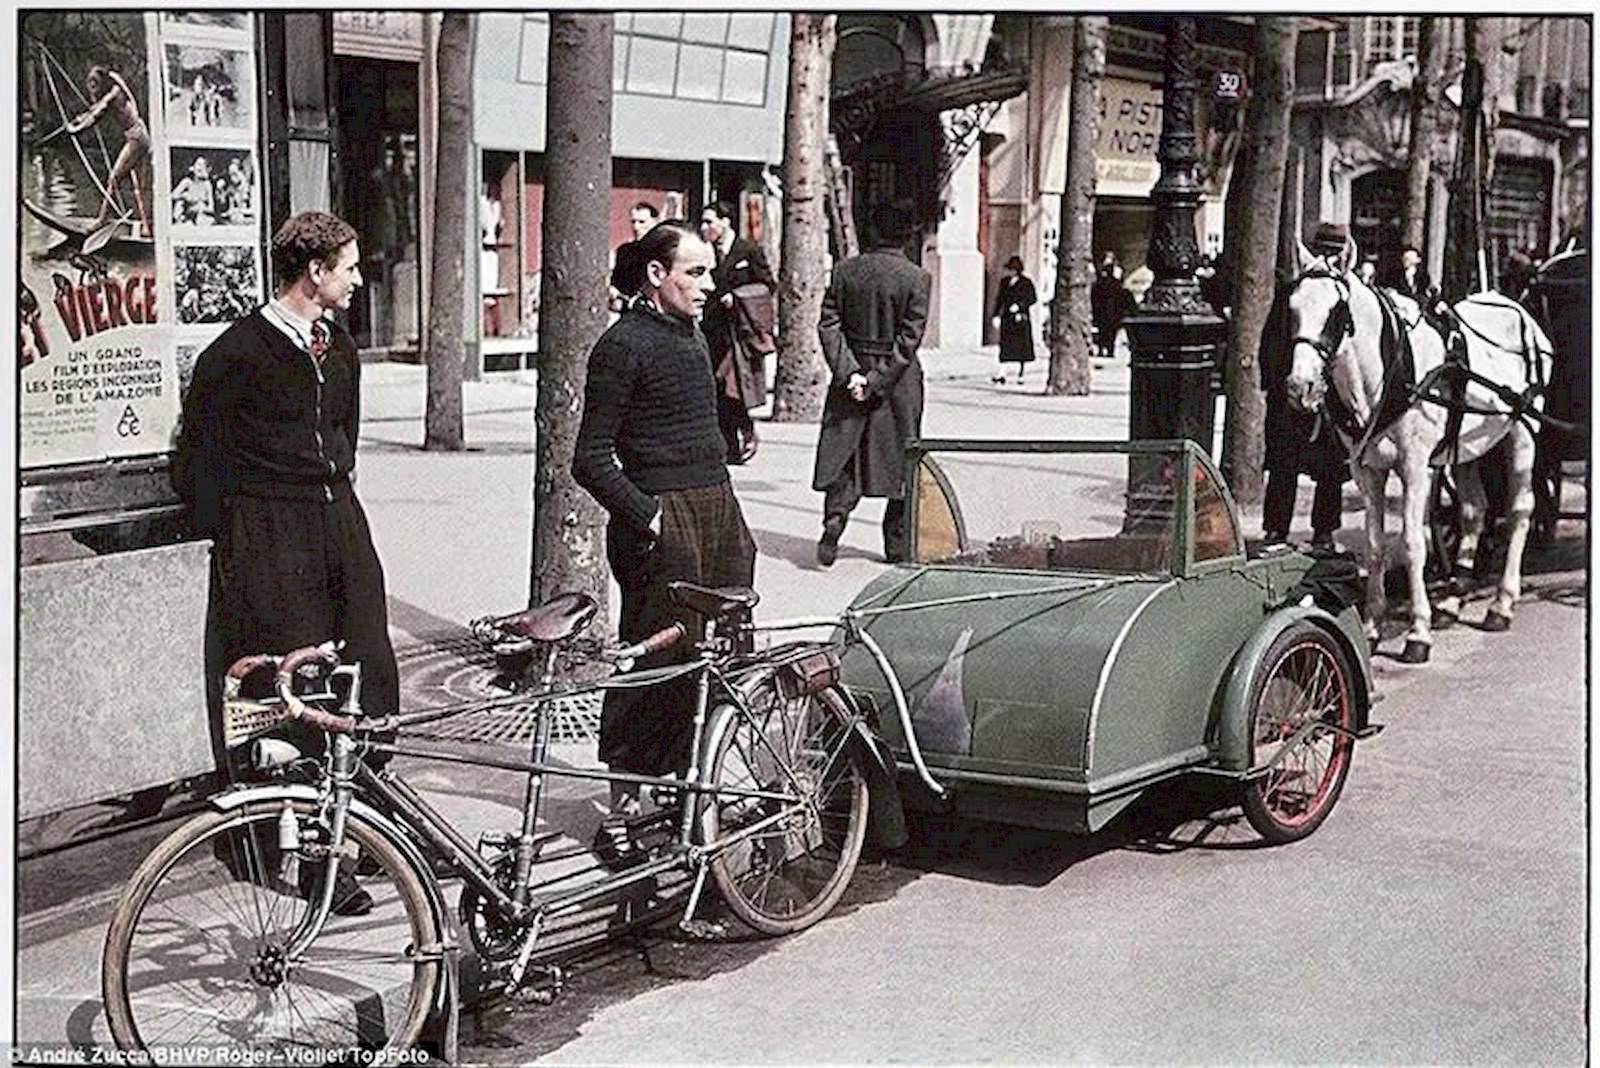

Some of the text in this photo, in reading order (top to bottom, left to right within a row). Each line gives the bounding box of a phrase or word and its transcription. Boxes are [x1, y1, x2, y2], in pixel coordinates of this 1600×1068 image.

[53, 274, 158, 343] VIERGE
[68, 347, 143, 363] UN GRAND
[54, 360, 162, 377] FILM D'EXPLORATION
[26, 382, 49, 393] LES
[102, 372, 162, 386] INCONNUES
[55, 386, 162, 405] DE L'AMAZONE
